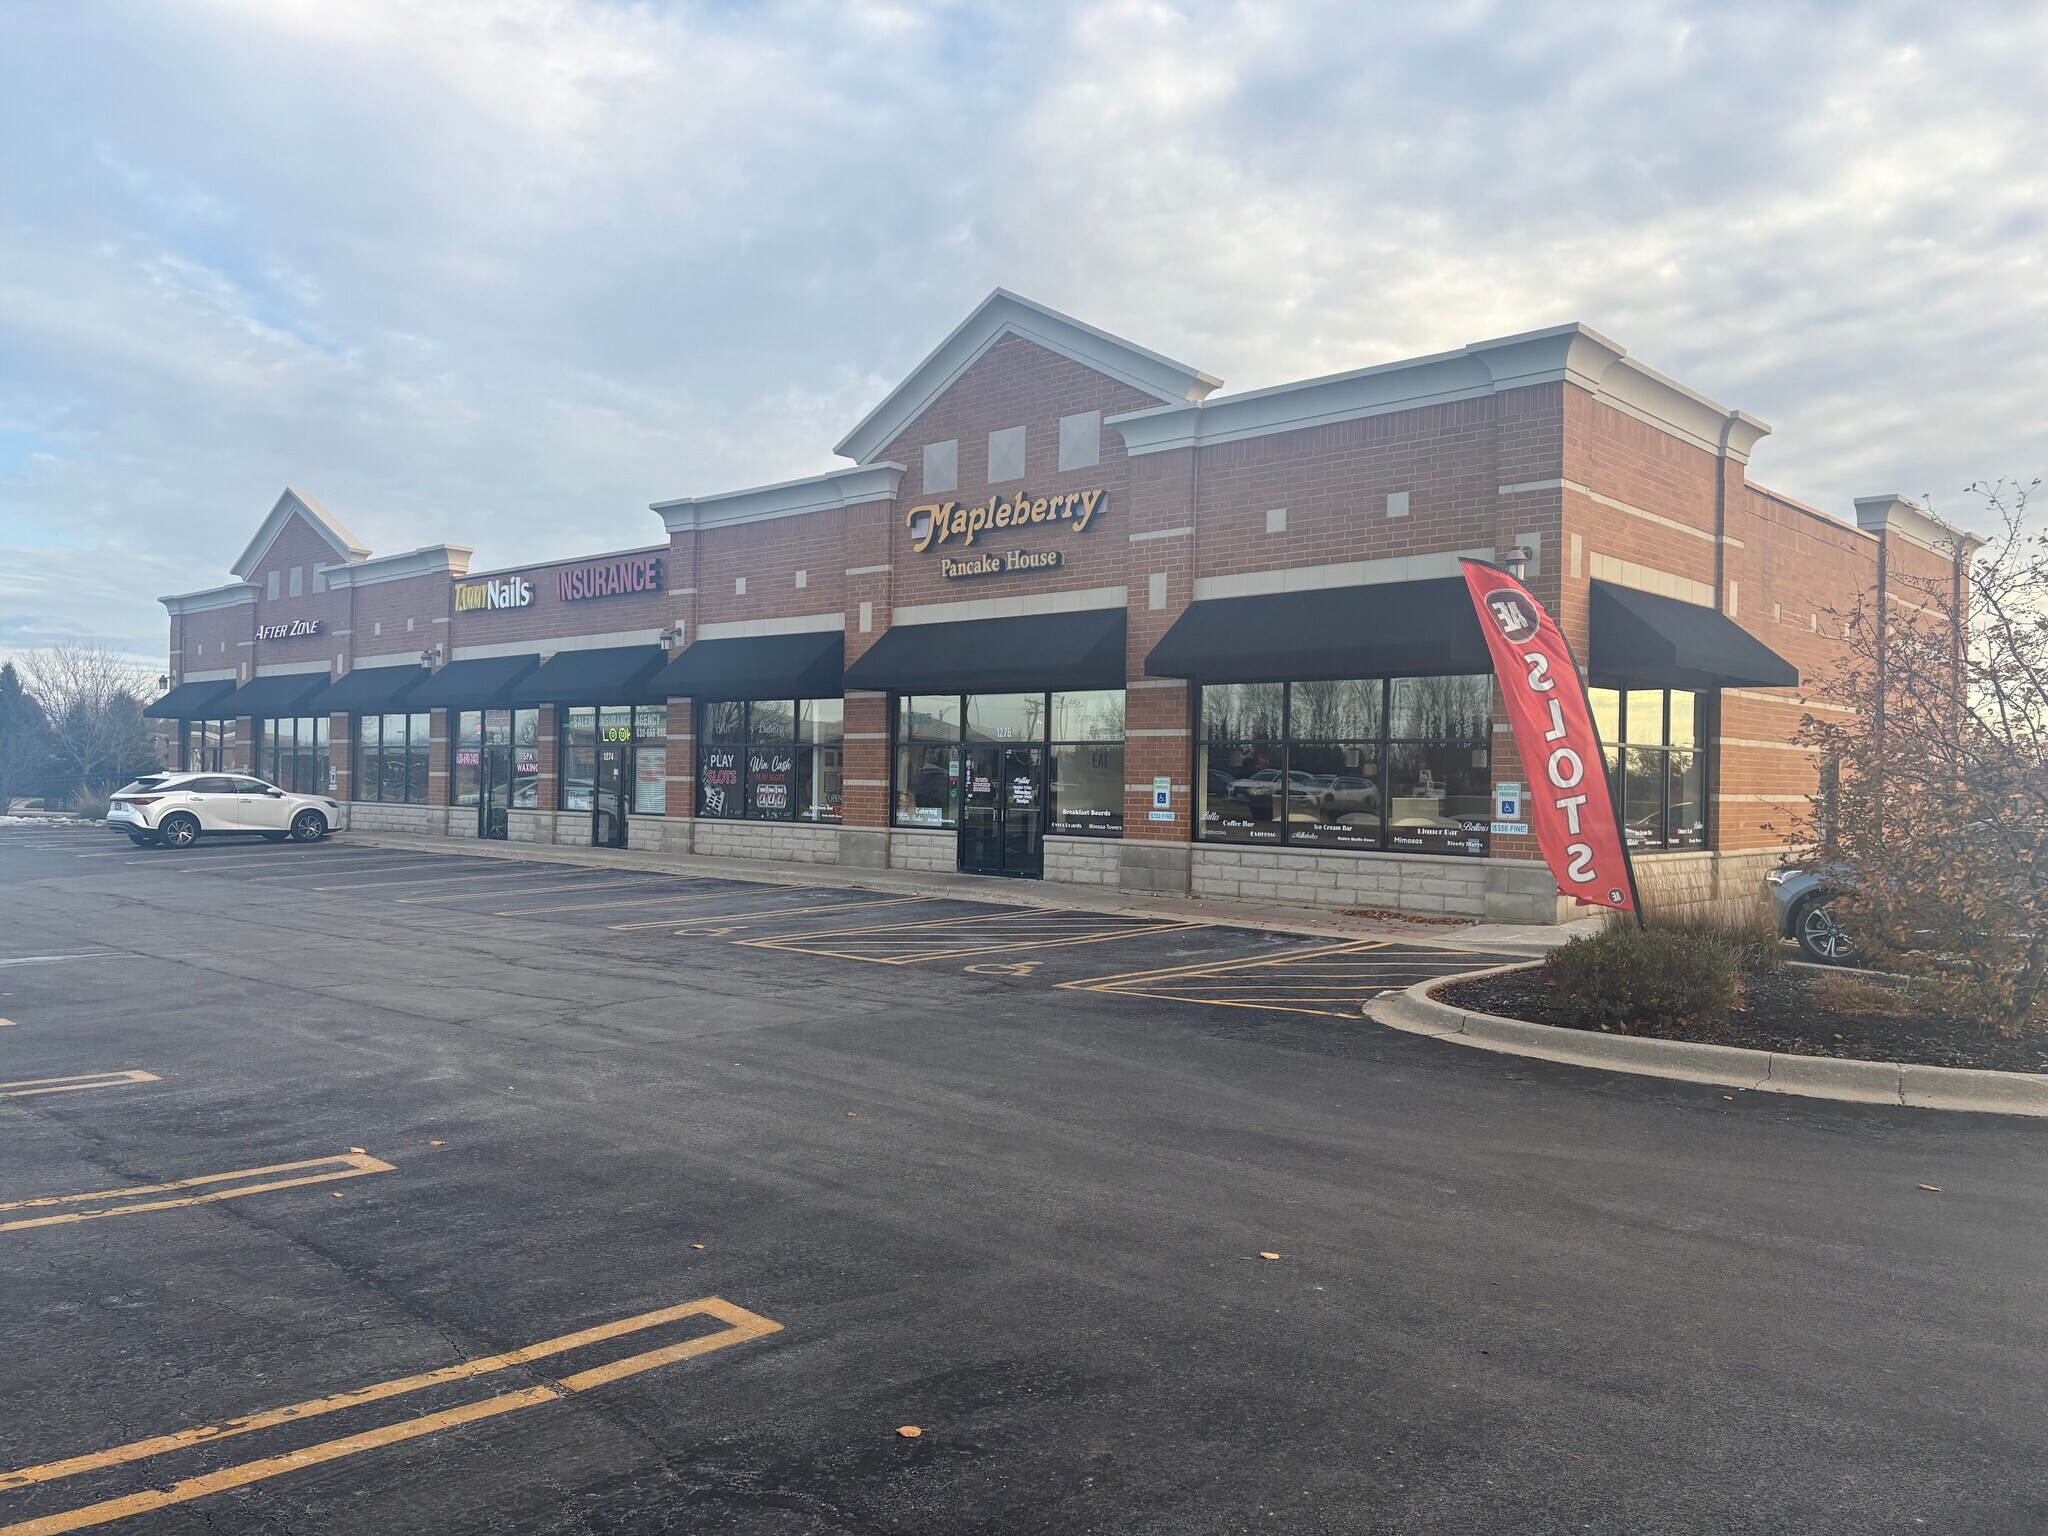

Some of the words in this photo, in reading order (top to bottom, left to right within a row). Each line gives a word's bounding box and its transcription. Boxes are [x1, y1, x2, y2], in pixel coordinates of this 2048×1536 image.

[906, 489, 1102, 552] Mapleberry
[941, 554, 1000, 578] Pancake
[1006, 550, 1057, 570] House
[557, 559, 656, 601] INSURANCE
[254, 624, 288, 641] AFTER
[290, 619, 319, 636] ZONE
[573, 715, 595, 728] SALEM
[599, 713, 631, 727] INSURANCE
[635, 713, 661, 727] AGENCY
[997, 727, 1012, 738] 1276
[522, 752, 534, 760] SPA
[603, 752, 614, 761] 1274
[710, 754, 735, 768] PLAY
[750, 756, 769, 773] Win
[771, 755, 792, 772] Cash
[706, 770, 737, 785] SLOTS
[769, 773, 785, 781] SLOTS
[1062, 808, 1090, 816] Breakfast
[1090, 809, 1111, 817] Boards
[1222, 819, 1242, 827] Coffee
[1242, 820, 1255, 828] Bar
[1509, 825, 1526, 833] FINE
[1393, 837, 1423, 845] Mimosas
